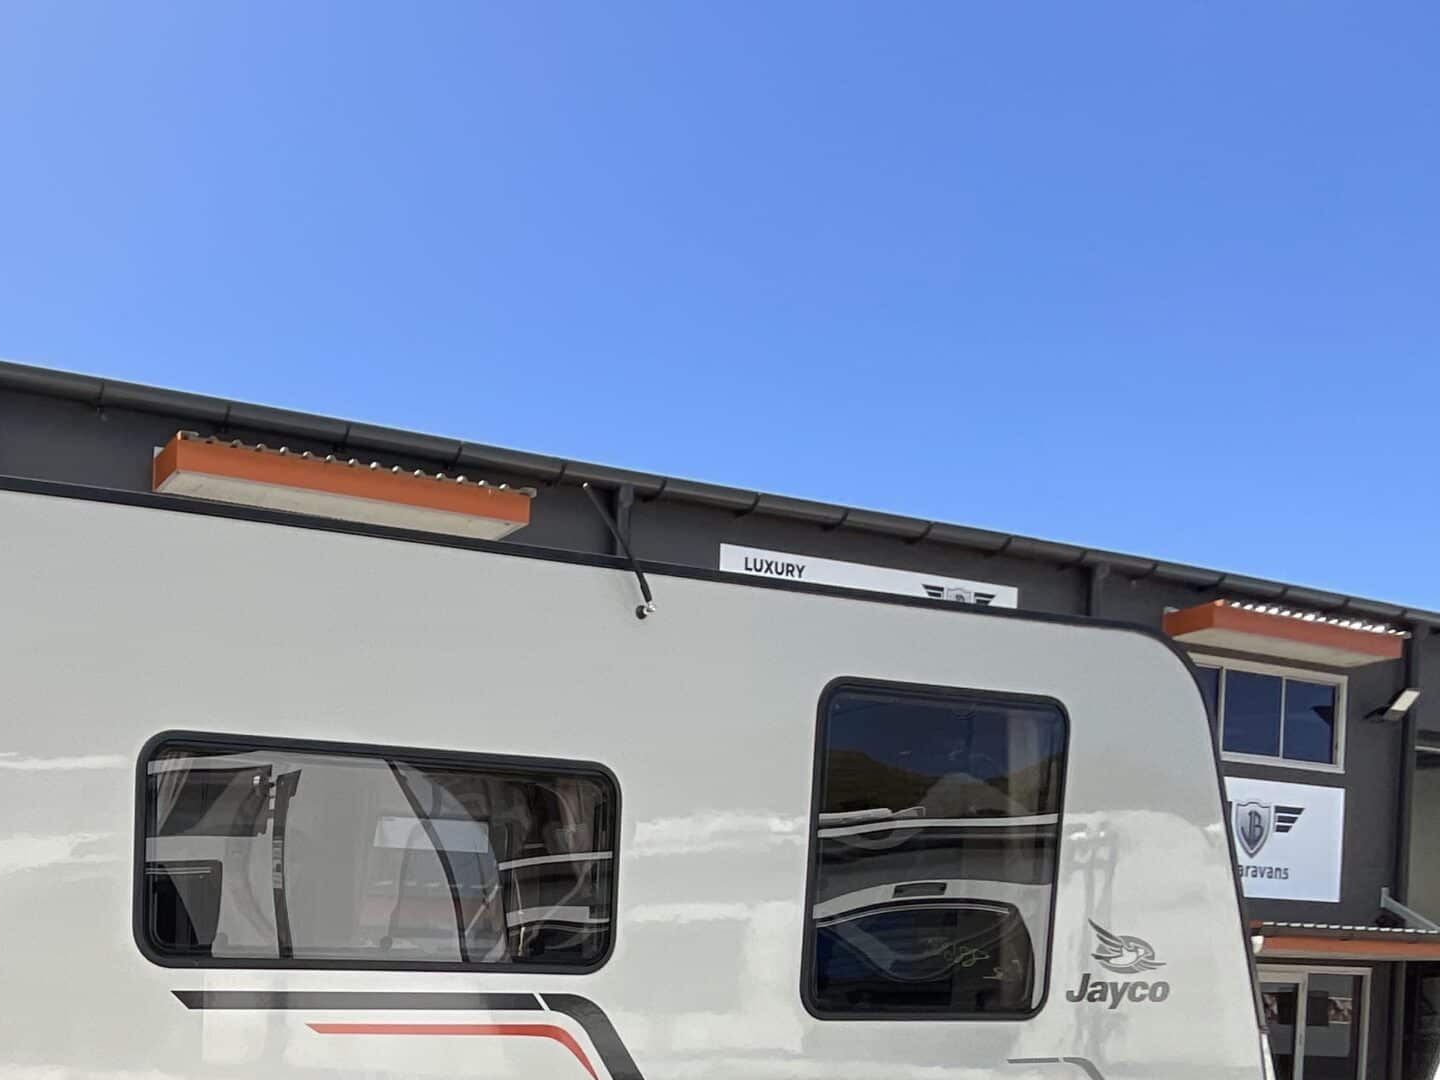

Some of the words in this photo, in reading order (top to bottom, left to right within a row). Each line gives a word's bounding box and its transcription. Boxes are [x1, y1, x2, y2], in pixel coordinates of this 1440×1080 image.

[744, 556, 806, 579] LUXURY
[1238, 864, 1289, 880] aravans
[1065, 973, 1170, 1010] Jayco
